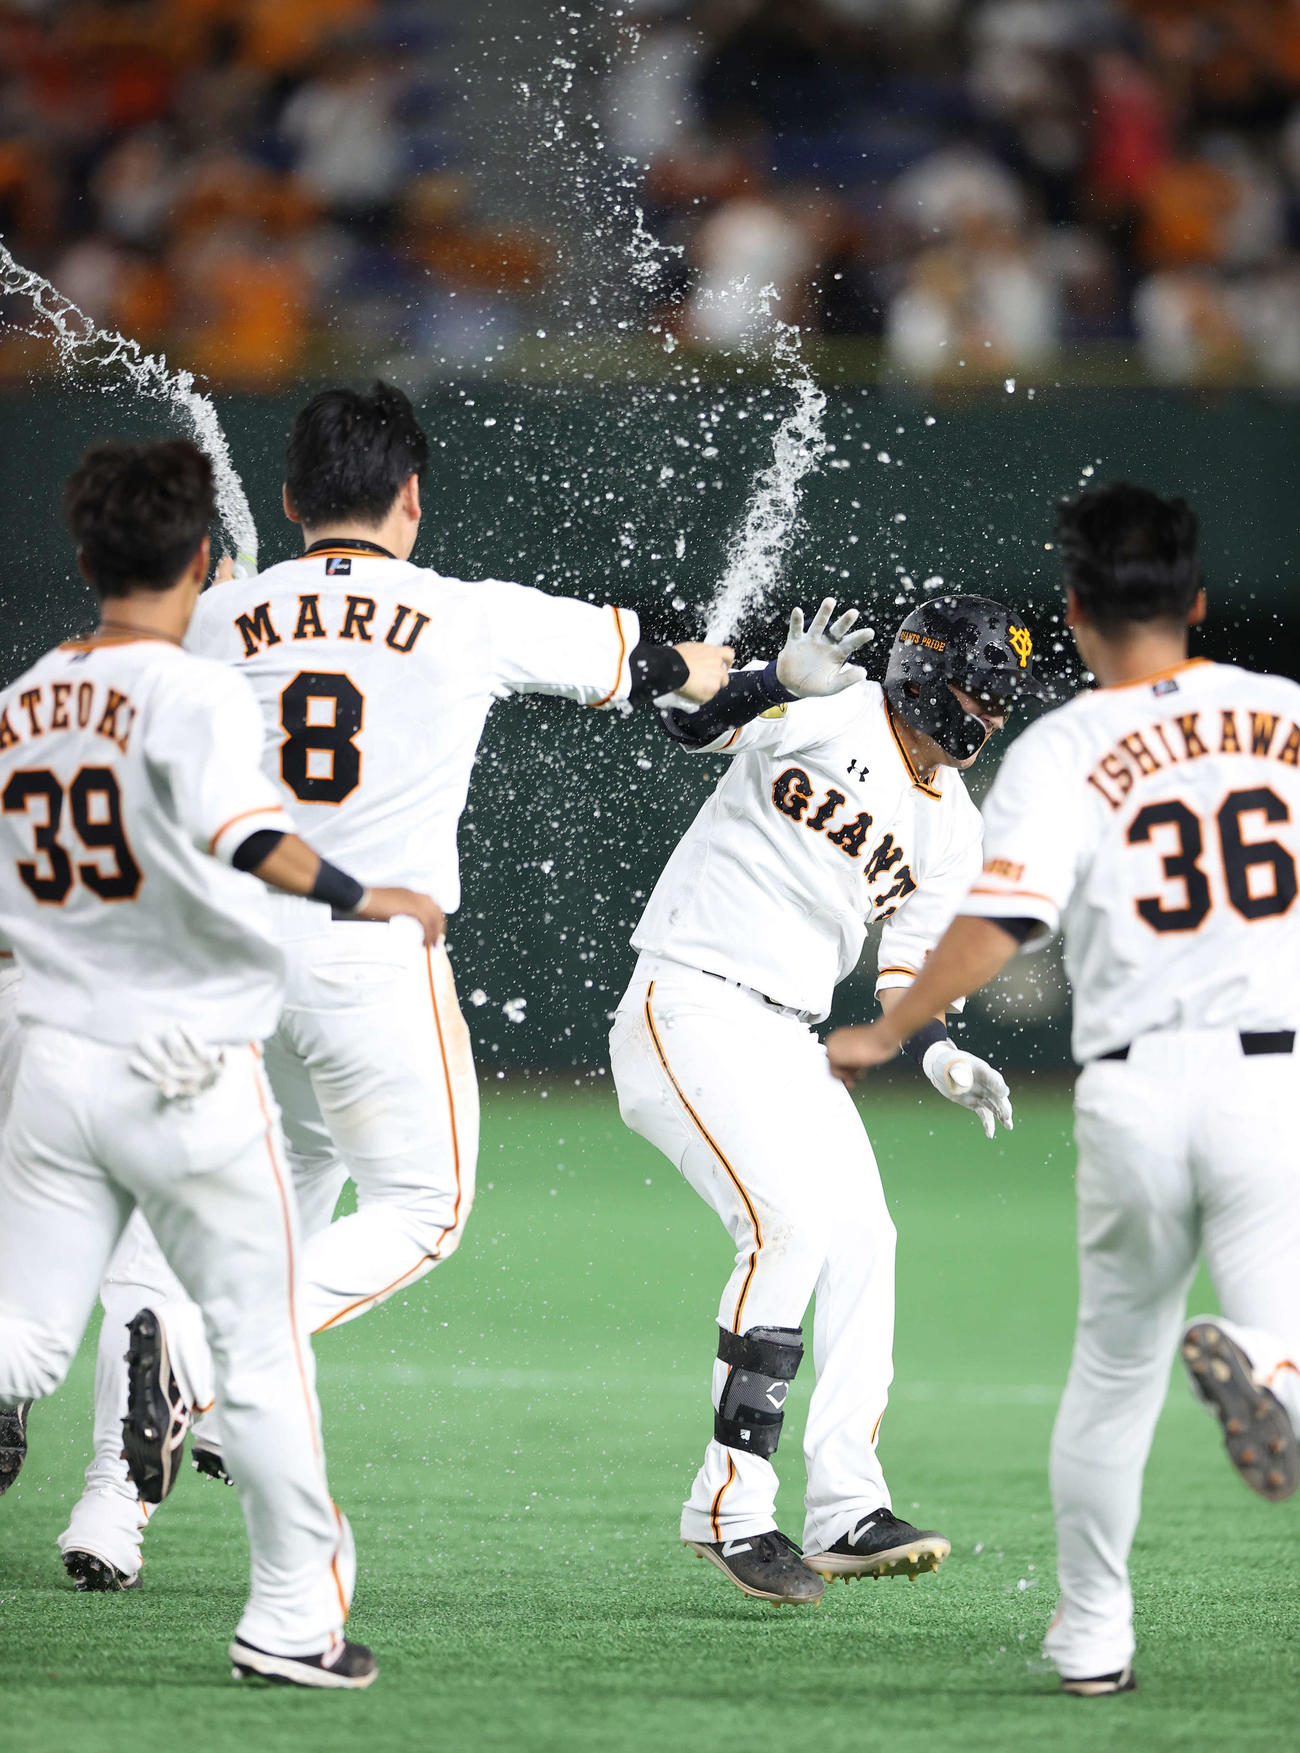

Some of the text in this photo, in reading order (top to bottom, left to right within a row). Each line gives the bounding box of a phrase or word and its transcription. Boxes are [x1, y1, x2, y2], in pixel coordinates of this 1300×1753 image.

[234, 593, 432, 659] MARU
[921, 636, 946, 652] PRIDE
[280, 670, 365, 806] 8
[1087, 708, 1300, 811] ISHIKAWA
[1, 766, 144, 908] 39
[1124, 786, 1300, 936] 36
